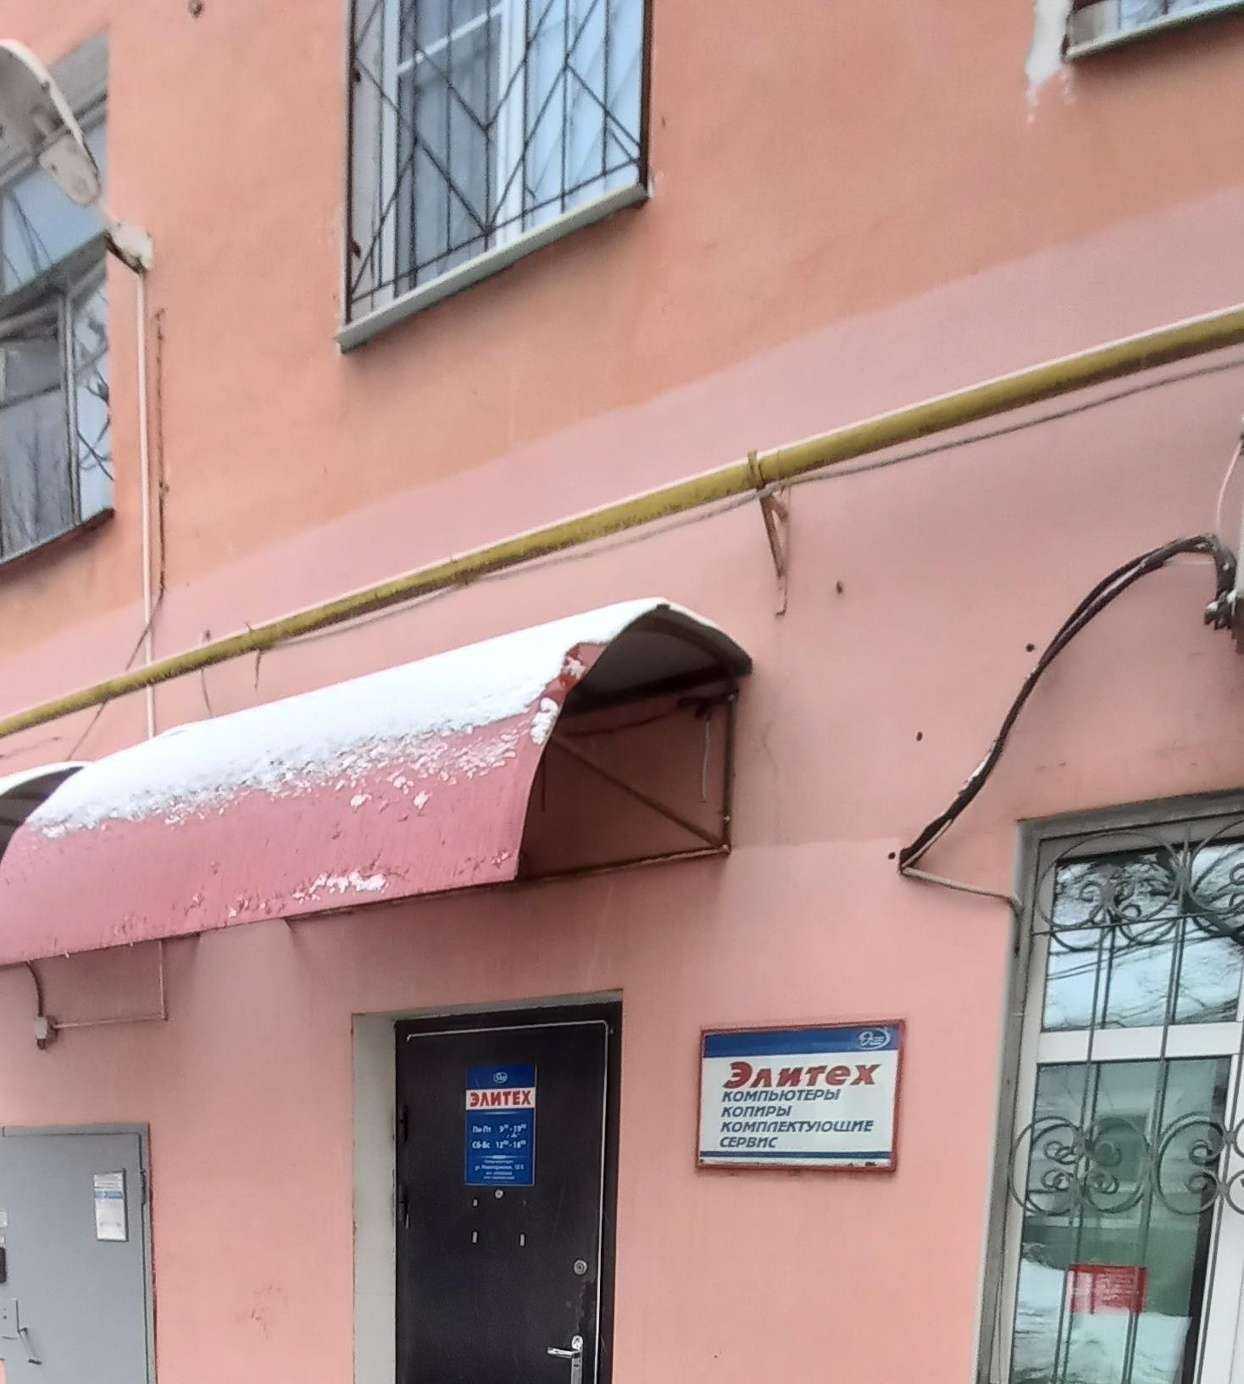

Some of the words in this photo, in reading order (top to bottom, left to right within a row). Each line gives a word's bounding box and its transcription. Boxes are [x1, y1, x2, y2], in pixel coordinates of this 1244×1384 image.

[470, 1090, 531, 1107] ЭЛИТЕХ
[721, 1088, 841, 1103] КОМПЬЮТЕРЫ
[720, 1105, 793, 1118] КОПИРЫ
[719, 1120, 874, 1133] КОМПЛЕКТУЮЩИЕ
[719, 1136, 778, 1149] СЕРВИС
